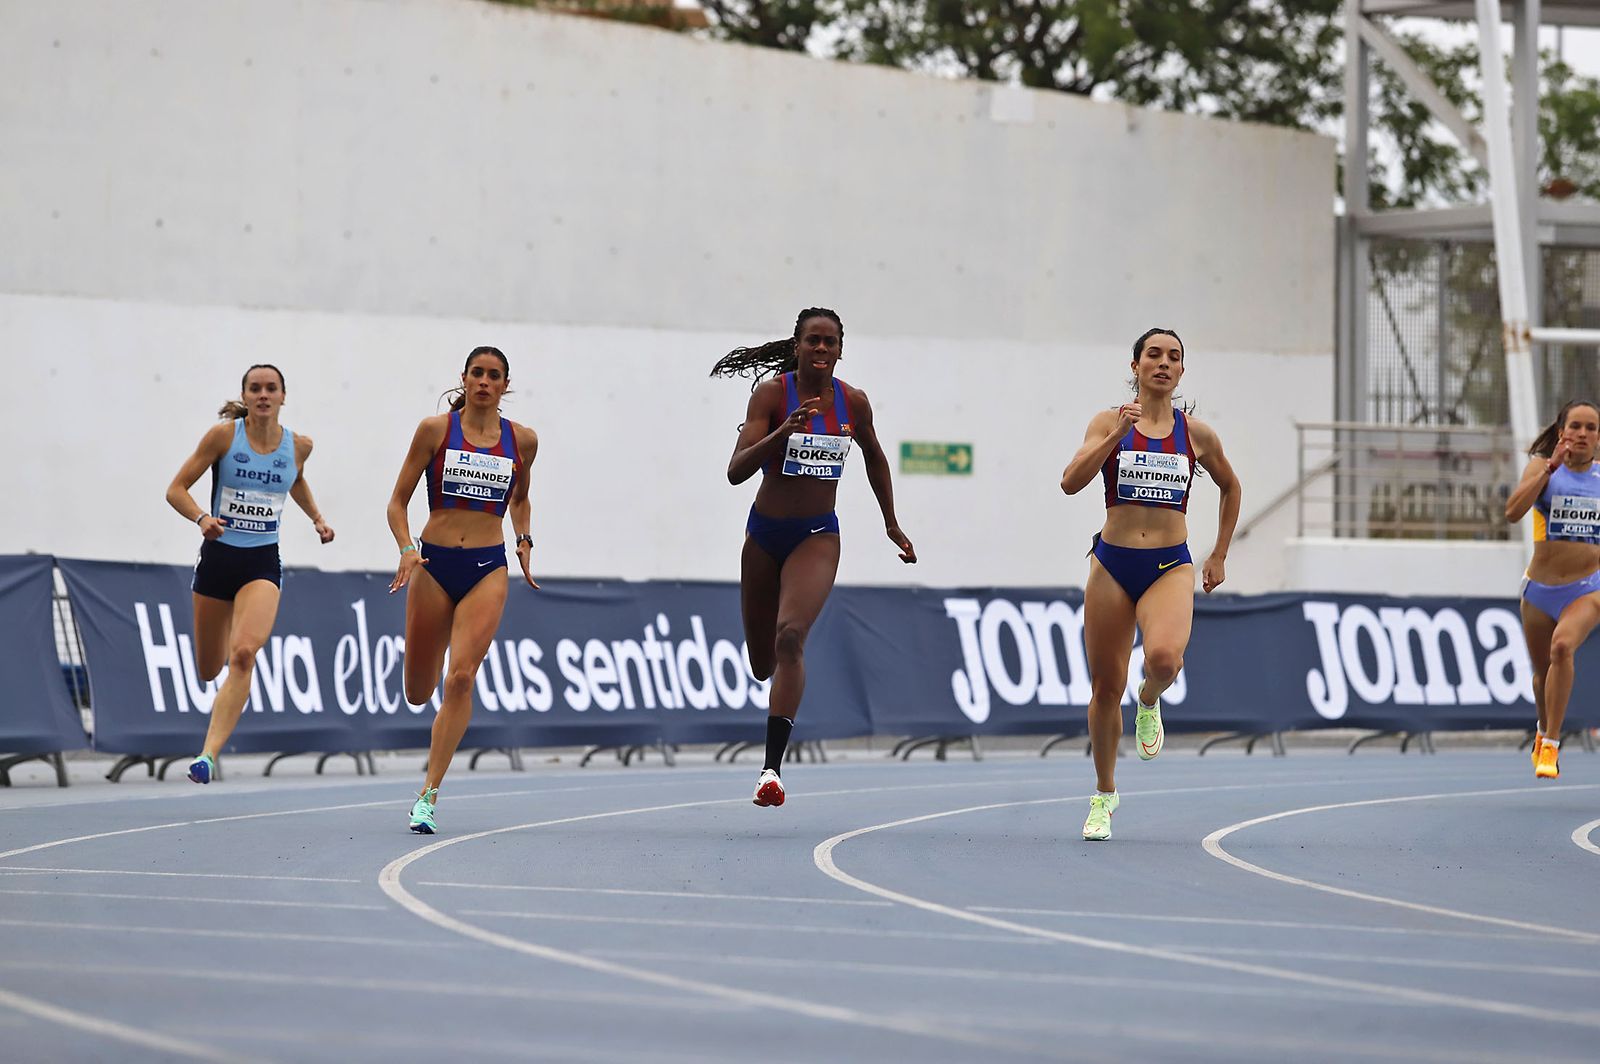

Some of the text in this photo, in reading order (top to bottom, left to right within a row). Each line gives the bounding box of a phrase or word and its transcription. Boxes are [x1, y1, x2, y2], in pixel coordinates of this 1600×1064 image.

[789, 448, 845, 462] BOKESA
[235, 468, 282, 484] nerja
[445, 467, 510, 484] HERNANDEZ
[1120, 469, 1189, 484] SANTIDRIAN
[228, 502, 274, 517] PARRA
